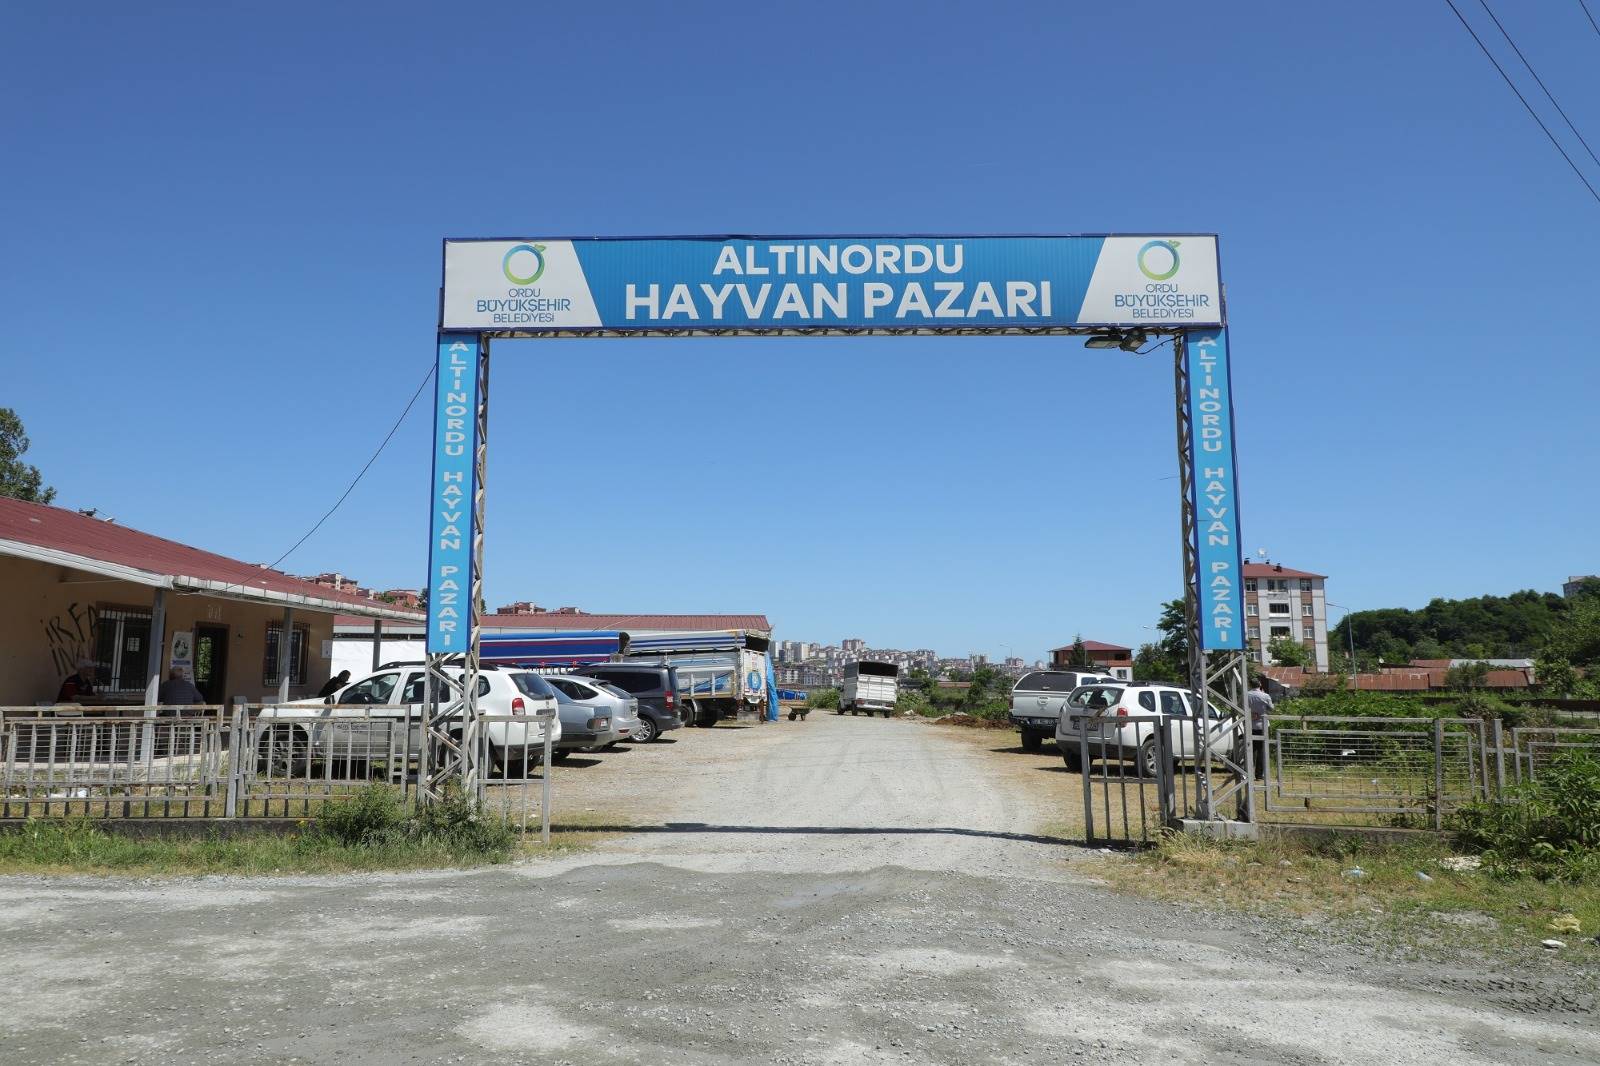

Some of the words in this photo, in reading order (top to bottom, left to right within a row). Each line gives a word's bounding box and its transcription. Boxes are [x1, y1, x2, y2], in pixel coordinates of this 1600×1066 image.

[712, 244, 964, 276] ALTINORDU
[477, 298, 571, 312] BÜYÜKŞEHİR
[508, 287, 541, 298] ORDU
[624, 282, 848, 321] HAYVAN
[863, 280, 1052, 319] PAZARI
[1114, 294, 1209, 308] BÜYÜKŞEHİR
[1145, 283, 1178, 293] ORDU
[493, 312, 554, 323] BELEDİYESİ
[1132, 308, 1194, 319] BELEDİYESİ
[445, 341, 469, 456] ALTINORDU
[1197, 336, 1222, 452] ALTINORDU
[441, 471, 464, 550] HAYVAN
[1204, 467, 1229, 546] HAYVAN
[437, 565, 460, 646] PAZARI
[1210, 561, 1233, 642] PAZARI
